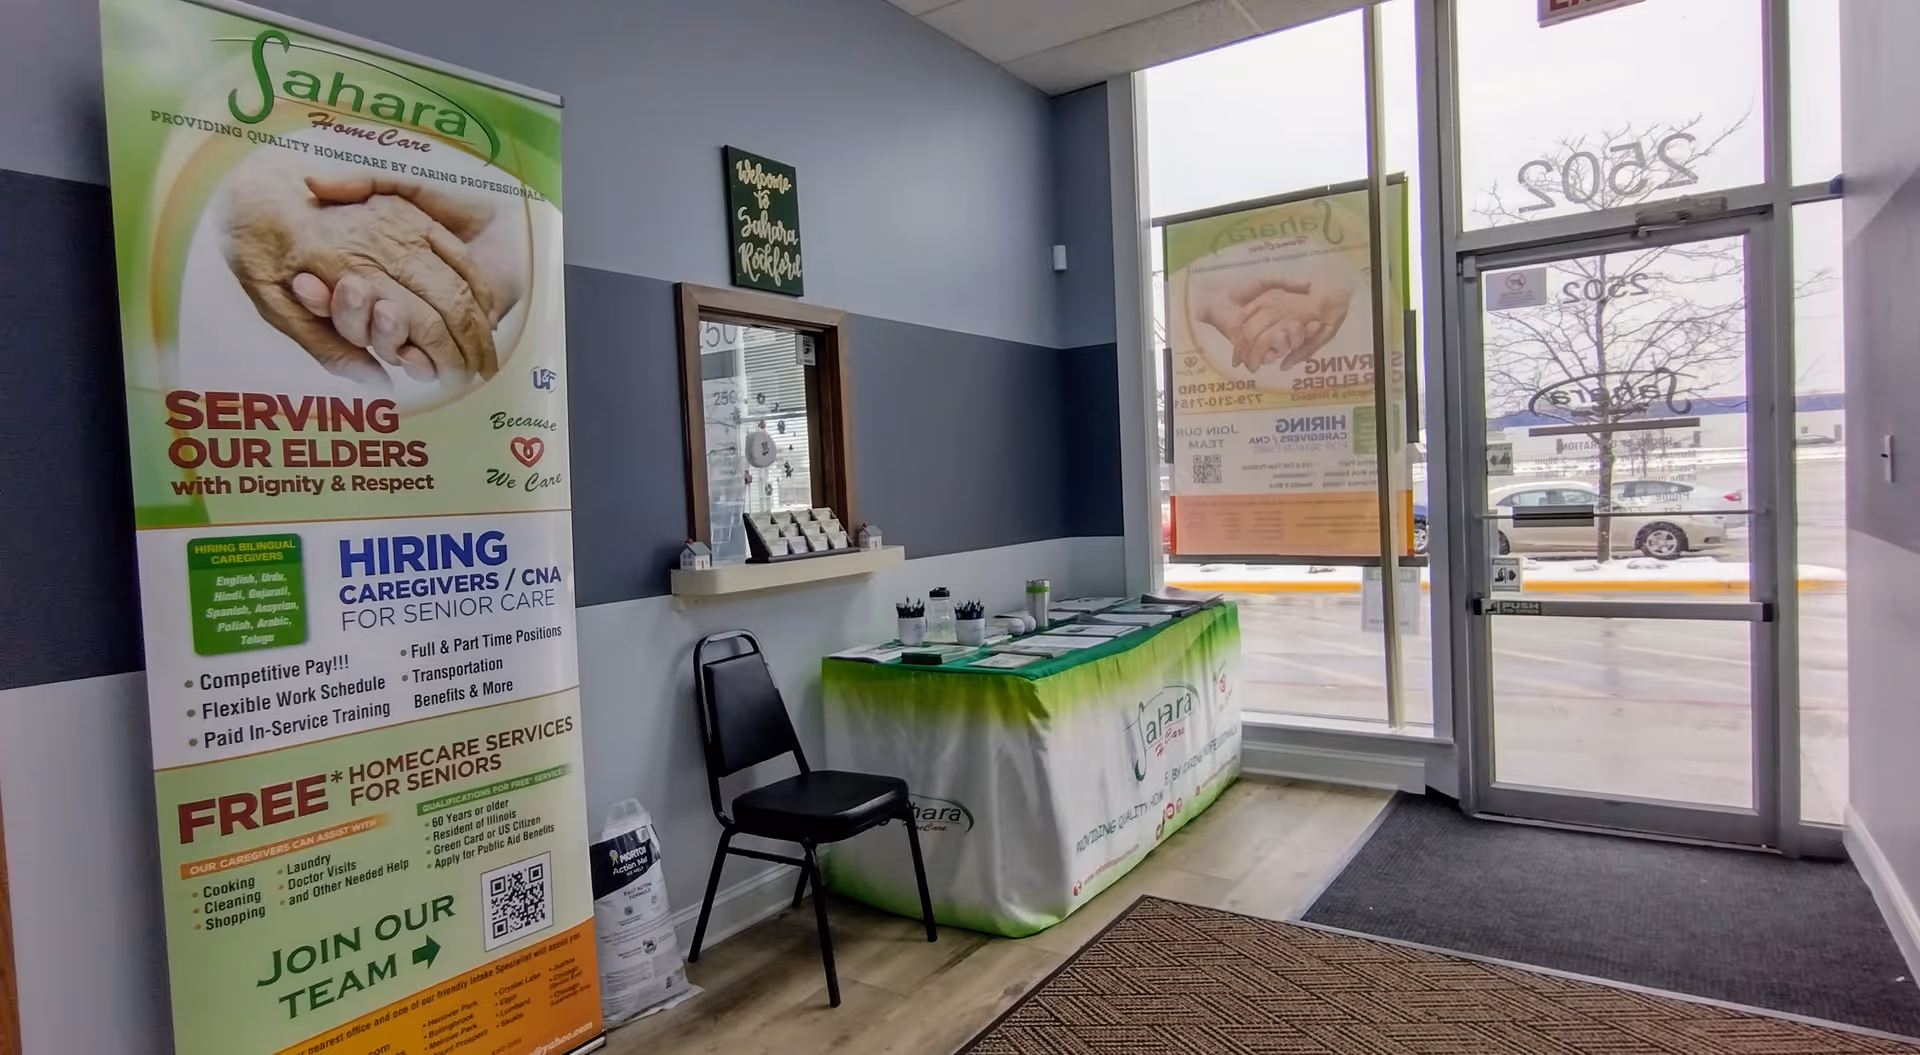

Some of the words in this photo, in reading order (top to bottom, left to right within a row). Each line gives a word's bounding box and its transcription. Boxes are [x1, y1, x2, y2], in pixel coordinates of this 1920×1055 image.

[228, 30, 467, 138] Sahara
[308, 111, 433, 153] HomeCare
[151, 109, 243, 138] PROVIDING
[247, 130, 311, 154] QUALITY
[314, 144, 388, 171] HOMECARE
[392, 160, 409, 174] BY
[411, 165, 458, 185] CARING
[460, 175, 547, 203] PROFESSIONALS
[736, 159, 792, 195] Welcome
[753, 190, 771, 210] to
[738, 206, 799, 246] Sahara
[739, 242, 802, 287] Rockford
[165, 390, 400, 434] SERVING
[489, 411, 557, 431] Because
[168, 437, 273, 469] OUR
[282, 438, 429, 469] ELDERS
[171, 475, 232, 496] with
[239, 474, 324, 497] Dignity
[330, 475, 346, 492] &
[351, 473, 435, 495] Respect
[486, 468, 517, 489] We
[524, 472, 562, 493] Care
[194, 543, 236, 554] HIRING
[238, 540, 296, 552] BILINGUAL
[211, 552, 284, 565] CAREGIVERS
[339, 530, 508, 578] HIRING
[216, 573, 258, 588] English,
[339, 571, 500, 605] CAREGIVERS
[504, 567, 517, 591] /
[521, 565, 562, 586] CNA
[205, 604, 252, 620] Spanish,
[217, 620, 254, 633] Polish,
[257, 615, 292, 629] Arabic,
[341, 606, 396, 632] FOR
[403, 596, 494, 623] SENIOR
[500, 588, 556, 612] CARE
[411, 641, 436, 659] Full
[440, 639, 450, 655] &
[454, 636, 480, 653] Part
[482, 633, 513, 649] Time
[516, 625, 562, 644] Positions
[200, 663, 301, 691] Competitive
[305, 654, 349, 676] Pay!!!
[412, 658, 504, 684] Transportation
[202, 695, 272, 720] Flexible
[275, 686, 317, 708] Work
[320, 675, 386, 700] Schedule
[414, 687, 466, 709] Benefits
[469, 683, 479, 699] &
[483, 679, 514, 696] More
[204, 727, 244, 749] Paid
[250, 714, 329, 741] In-Service
[332, 702, 391, 725] Training
[349, 738, 481, 785] HOMECARE
[486, 716, 573, 752] SERVICES
[351, 778, 401, 807] FOR
[407, 753, 502, 791] SENIORS
[422, 787, 492, 812] QUALIFICATIONS
[493, 783, 510, 793] FOR
[431, 815, 444, 828] 60
[446, 809, 472, 826] Years
[474, 806, 484, 815] or
[486, 799, 510, 814] older
[433, 822, 474, 843] Resident
[476, 819, 485, 830] of
[486, 810, 517, 827] Illinois
[190, 862, 217, 875] OUR
[219, 842, 290, 869] CAREGIVERS
[292, 836, 315, 850] CAN
[316, 827, 350, 843] ASSIST
[351, 819, 377, 832] WITH
[434, 840, 462, 855] Green
[464, 831, 485, 848] Card
[487, 829, 496, 838] or
[498, 824, 511, 836] US
[513, 815, 541, 833] Citizen
[434, 853, 461, 871] Apply
[463, 848, 475, 860] for
[477, 839, 505, 856] Public
[507, 833, 521, 847] Aid
[523, 824, 555, 842] Benefits
[287, 853, 332, 875] Laundry
[288, 870, 324, 890] Doctor
[327, 860, 357, 878] Visits
[612, 862, 637, 876] Action
[203, 877, 256, 899] Cooking
[288, 891, 310, 906] and
[313, 883, 342, 898] Other
[345, 866, 384, 888] Needed
[386, 859, 409, 873] Help
[204, 891, 262, 915] Cleaning
[205, 905, 266, 931] Shopping
[256, 926, 362, 988] JOIN
[374, 894, 456, 941] OUR
[278, 952, 397, 1019] TEAM
[307, 1033, 344, 1055] nearest
[374, 1011, 390, 1027] and
[495, 953, 532, 975] Specialist
